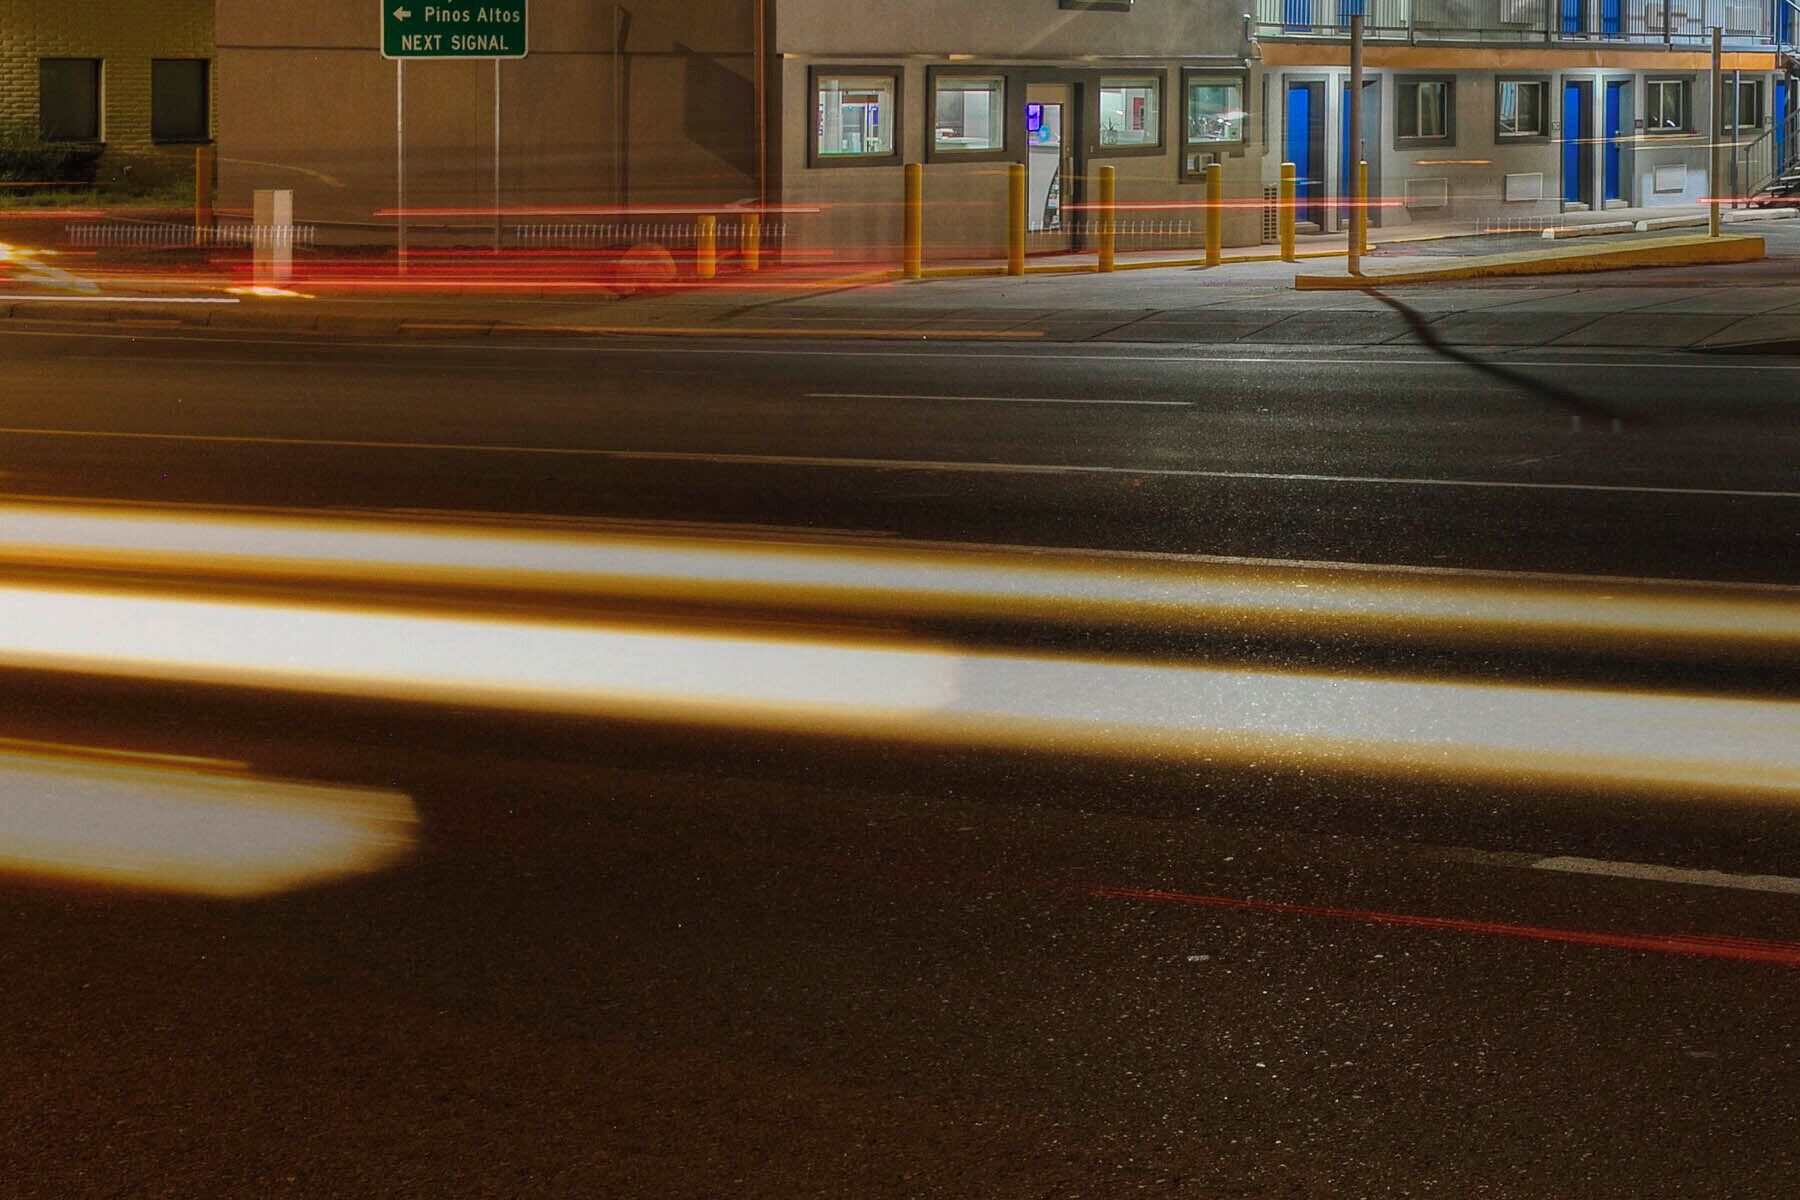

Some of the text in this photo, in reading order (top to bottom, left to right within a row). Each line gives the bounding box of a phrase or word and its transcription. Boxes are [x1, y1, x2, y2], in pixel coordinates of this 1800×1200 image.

[425, 7, 520, 22] Pinos Altos
[402, 35, 508, 50] NEXT SIGNAL
